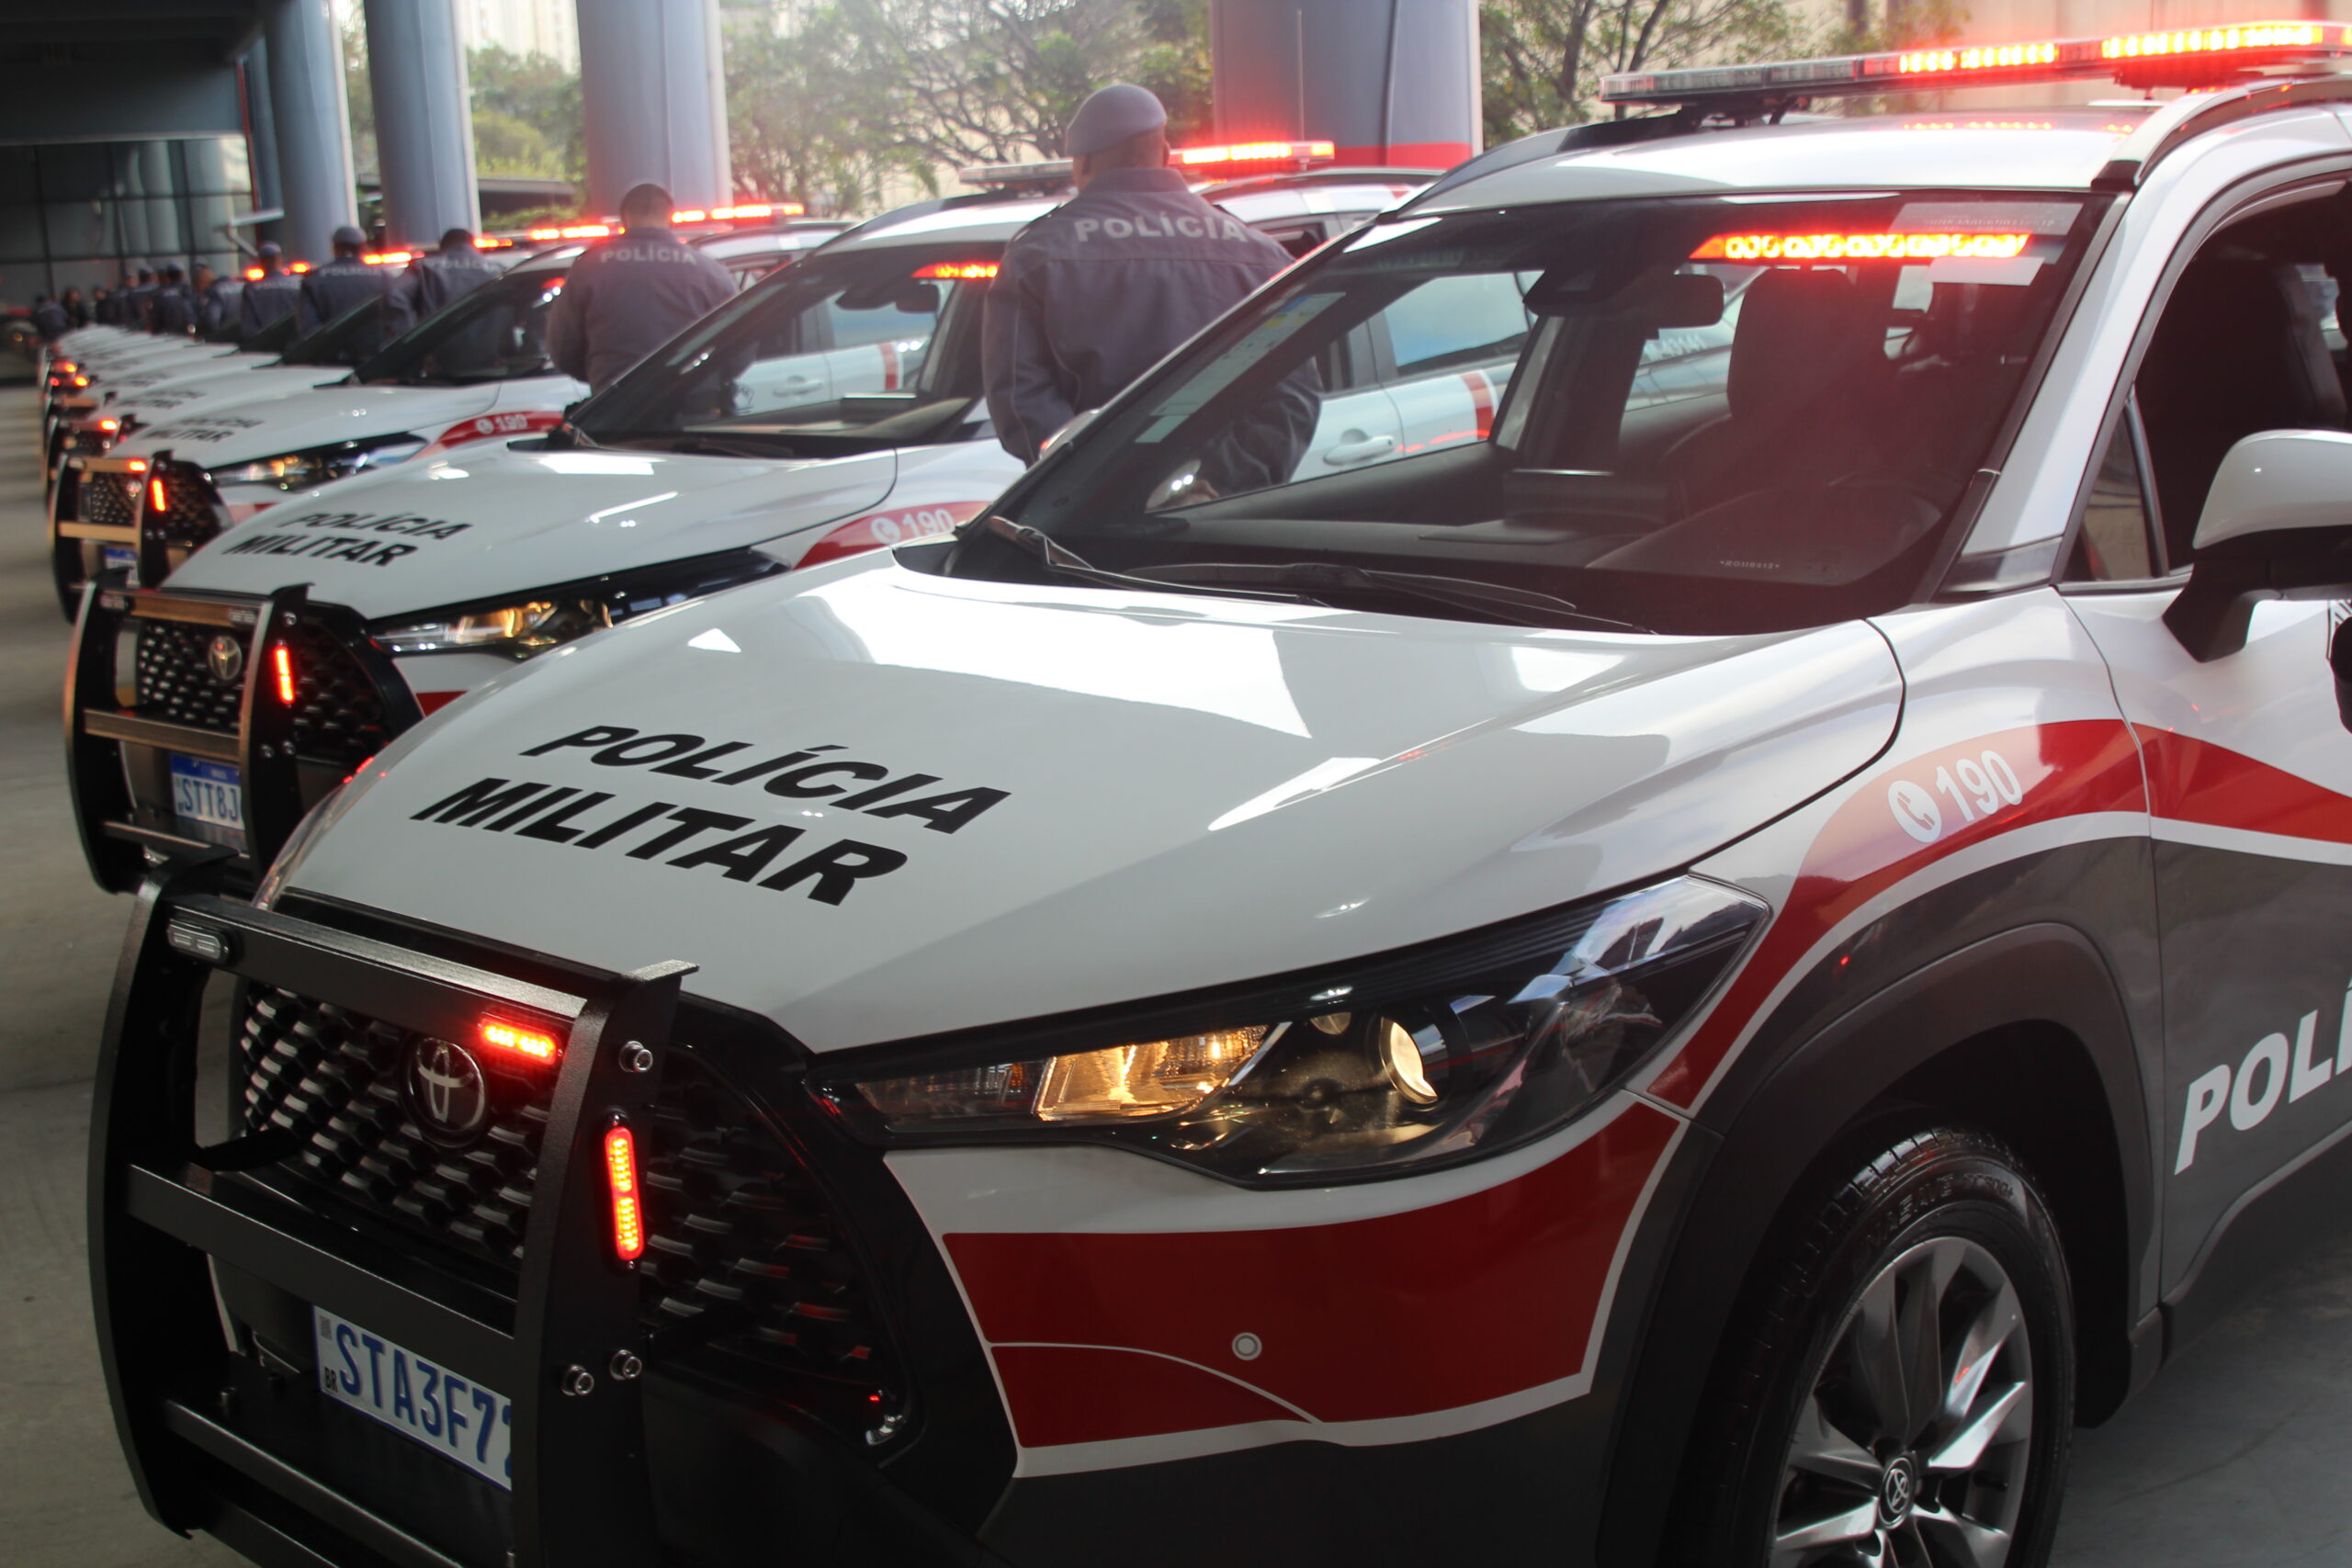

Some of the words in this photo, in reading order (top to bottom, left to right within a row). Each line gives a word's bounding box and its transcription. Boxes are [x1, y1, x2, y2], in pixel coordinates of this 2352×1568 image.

[1074, 210, 1249, 243] POLÍCIA
[601, 243, 697, 265] POLÍCIA
[495, 414, 528, 432] 190
[277, 513, 473, 540] POLÍCIA
[902, 509, 956, 537] 190
[220, 535, 419, 567] MILITAR
[518, 725, 1012, 835] POLÍCIA
[1935, 750, 2023, 822] 190
[182, 776, 240, 822] STT8J
[408, 777, 909, 906] MILITAR
[323, 1367, 338, 1393] BR
